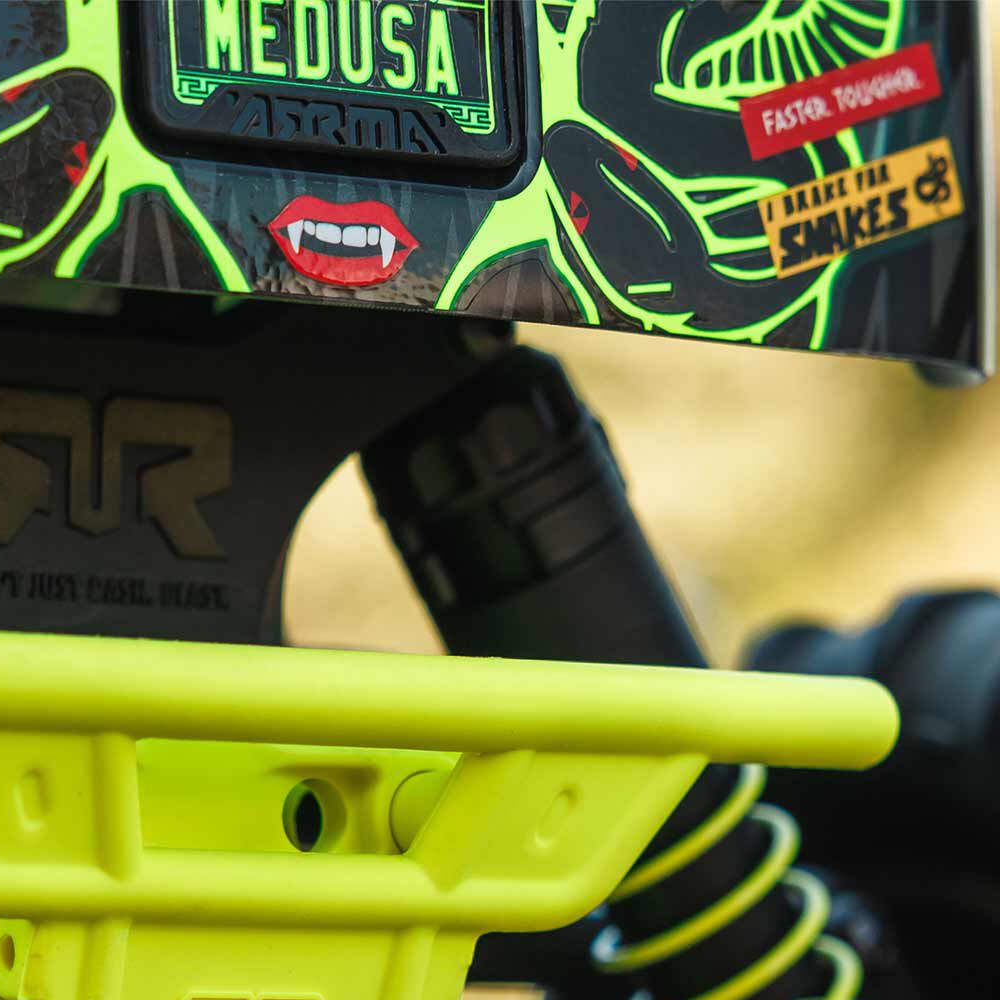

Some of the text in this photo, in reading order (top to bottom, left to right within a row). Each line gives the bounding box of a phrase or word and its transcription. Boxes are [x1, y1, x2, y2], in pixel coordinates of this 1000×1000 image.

[205, 0, 459, 96] MEDUSA
[766, 200, 773, 222] I
[782, 177, 848, 217] BRAKE
[778, 187, 909, 270] SNAKES
[27, 572, 77, 602] JUST
